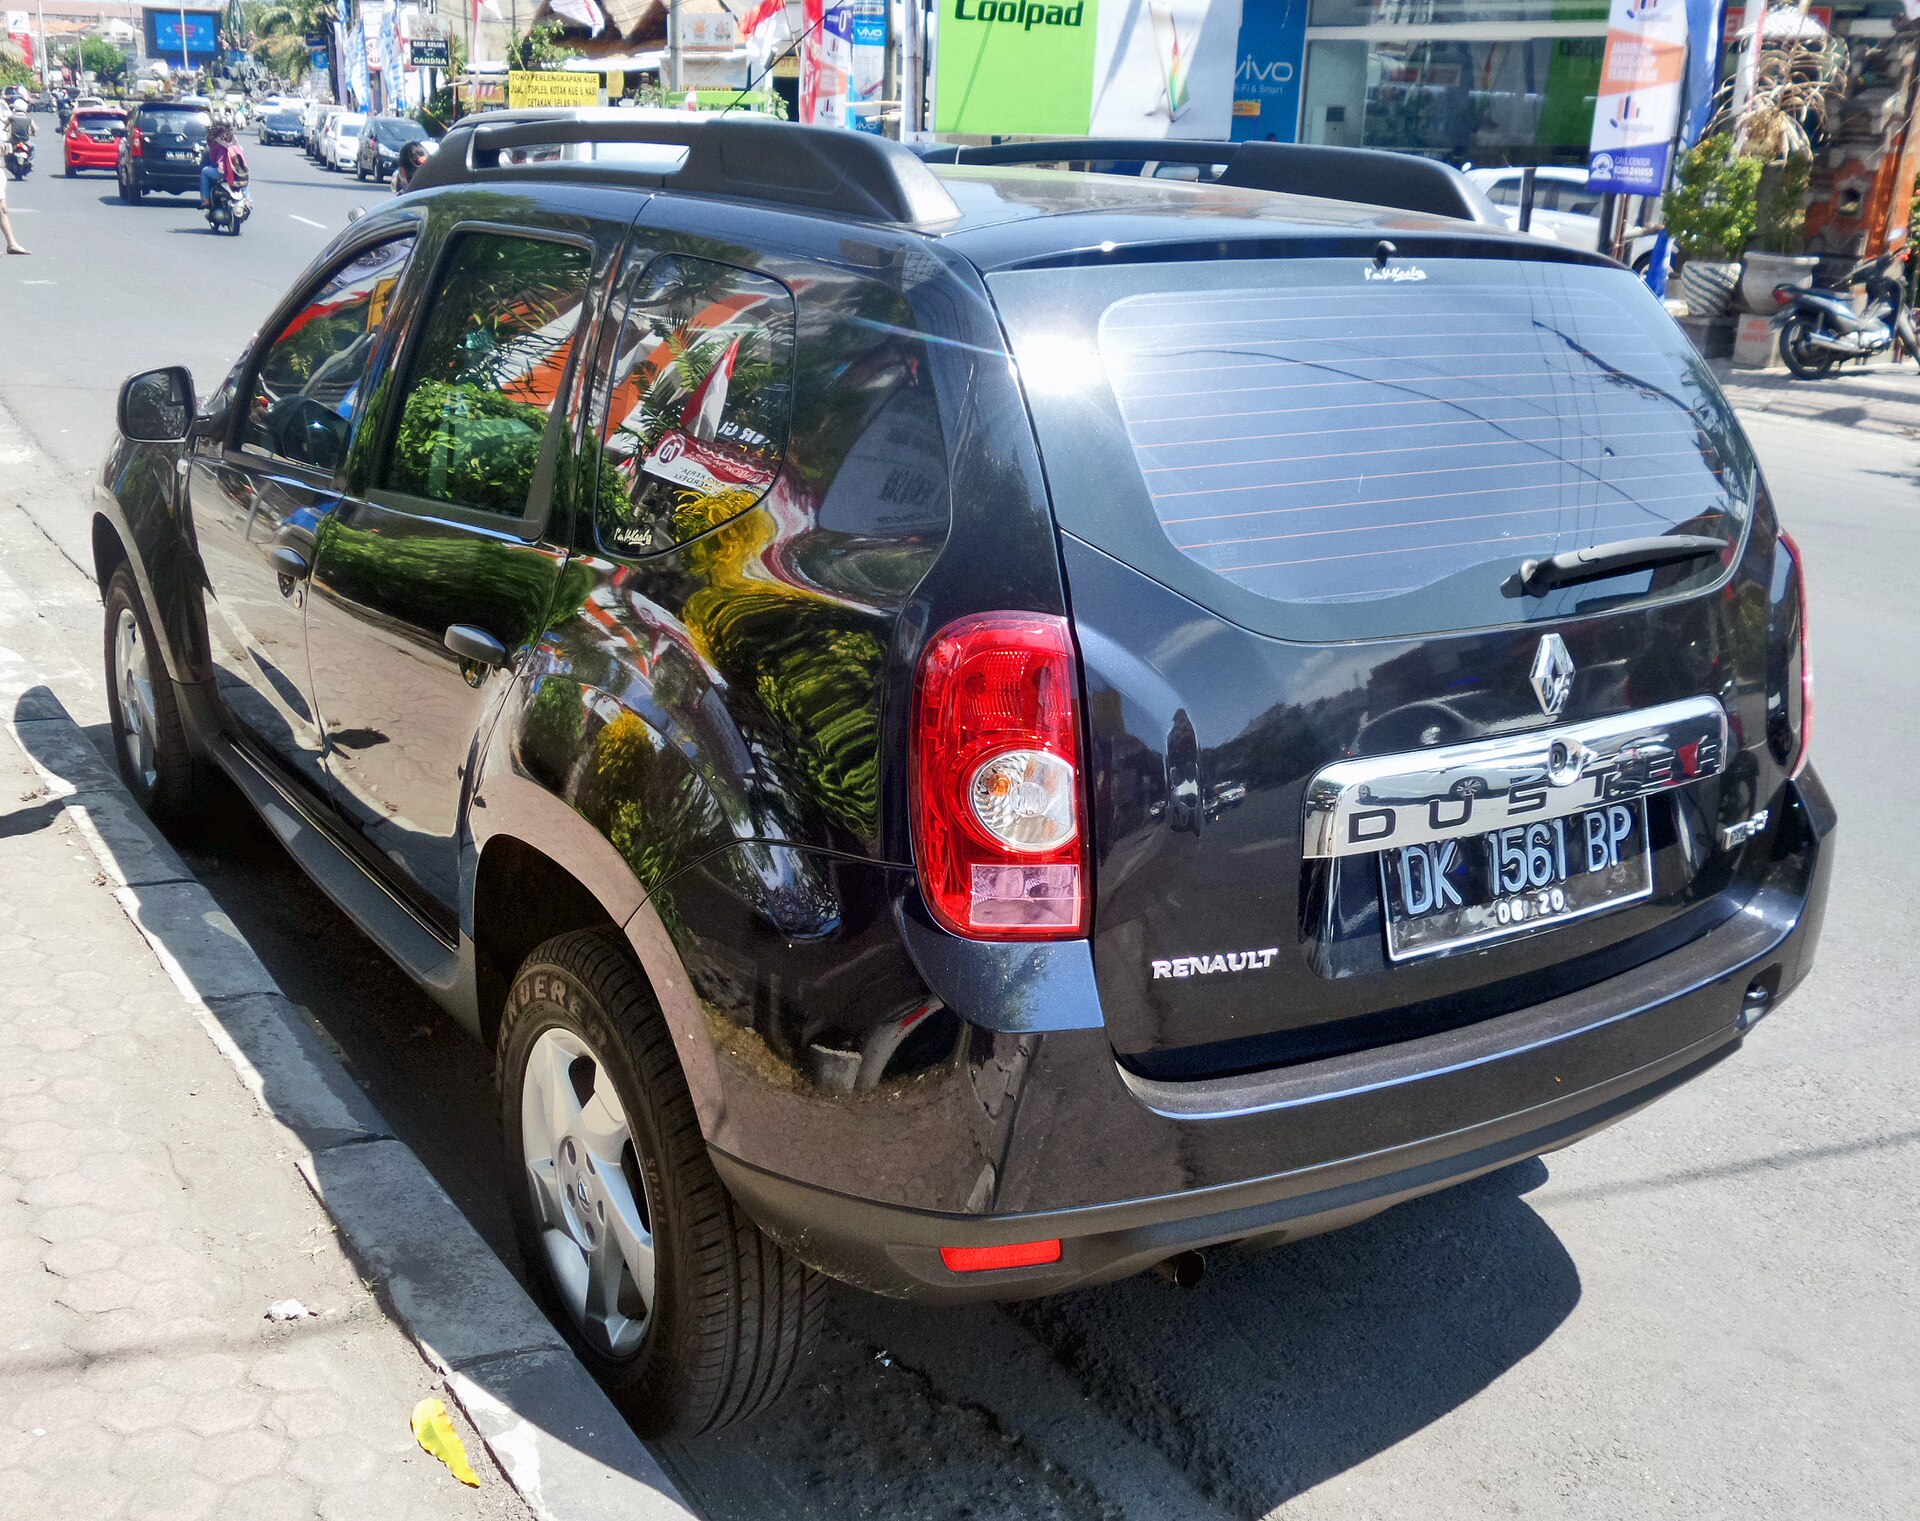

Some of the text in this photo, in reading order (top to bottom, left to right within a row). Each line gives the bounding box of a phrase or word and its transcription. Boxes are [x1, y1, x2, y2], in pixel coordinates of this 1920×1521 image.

[955, 0, 1084, 31] Coolpad
[857, 27, 883, 37] vivo
[413, 57, 448, 65] CANDRA
[511, 73, 597, 84] TOKO PERLENGKAPAN KUE
[550, 87, 567, 95] KOTAK
[568, 87, 579, 96] KUE
[1259, 85, 1283, 94] Smart
[1348, 733, 1723, 845] DUSTER
[1400, 839, 1463, 915] DK
[1485, 817, 1567, 898] 1561
[1583, 805, 1633, 874] BP
[1539, 889, 1565, 914] 20
[1151, 948, 1279, 980] RENAULT
